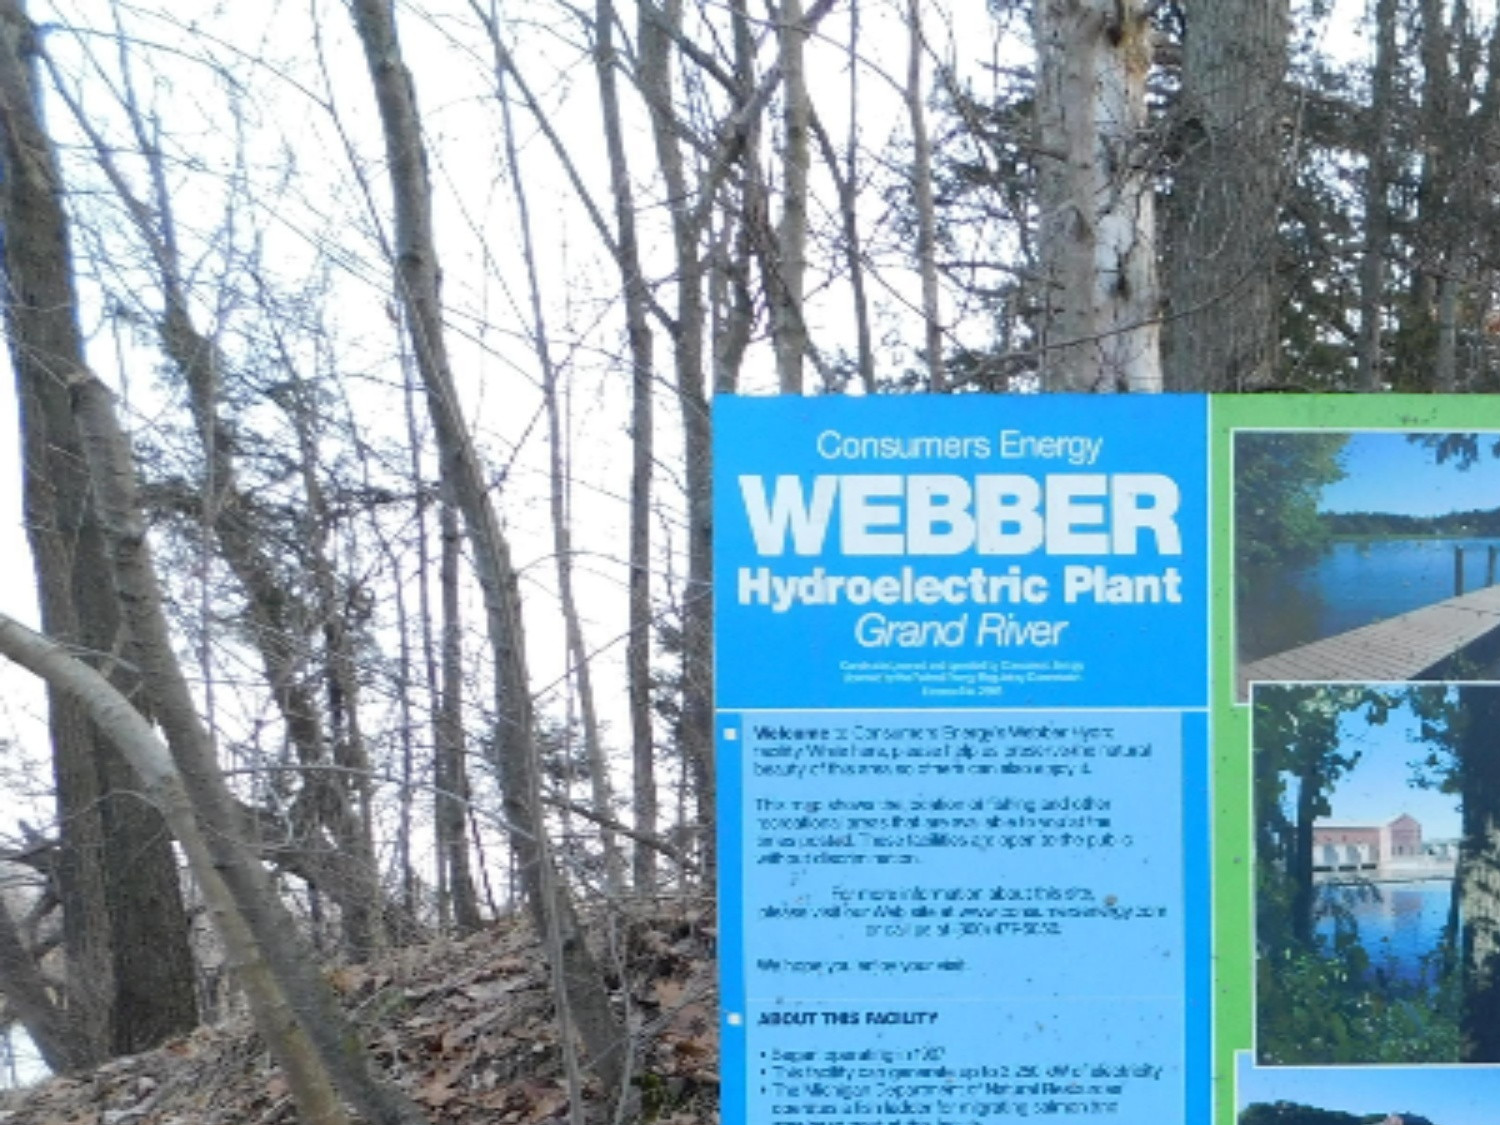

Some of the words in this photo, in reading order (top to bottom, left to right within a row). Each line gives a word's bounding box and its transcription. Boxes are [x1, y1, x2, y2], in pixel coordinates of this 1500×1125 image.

[817, 430, 991, 460] Consumers
[1000, 430, 1103, 464] Energy
[738, 473, 1183, 556] WEBBER
[738, 567, 1049, 613] Hydroelectric
[1064, 566, 1183, 604] Plant
[854, 613, 967, 648] Grand
[976, 614, 1069, 648] River
[757, 1012, 818, 1026] ABOUT
[821, 1012, 860, 1026] THIS
[865, 1012, 939, 1026] FACILITY
